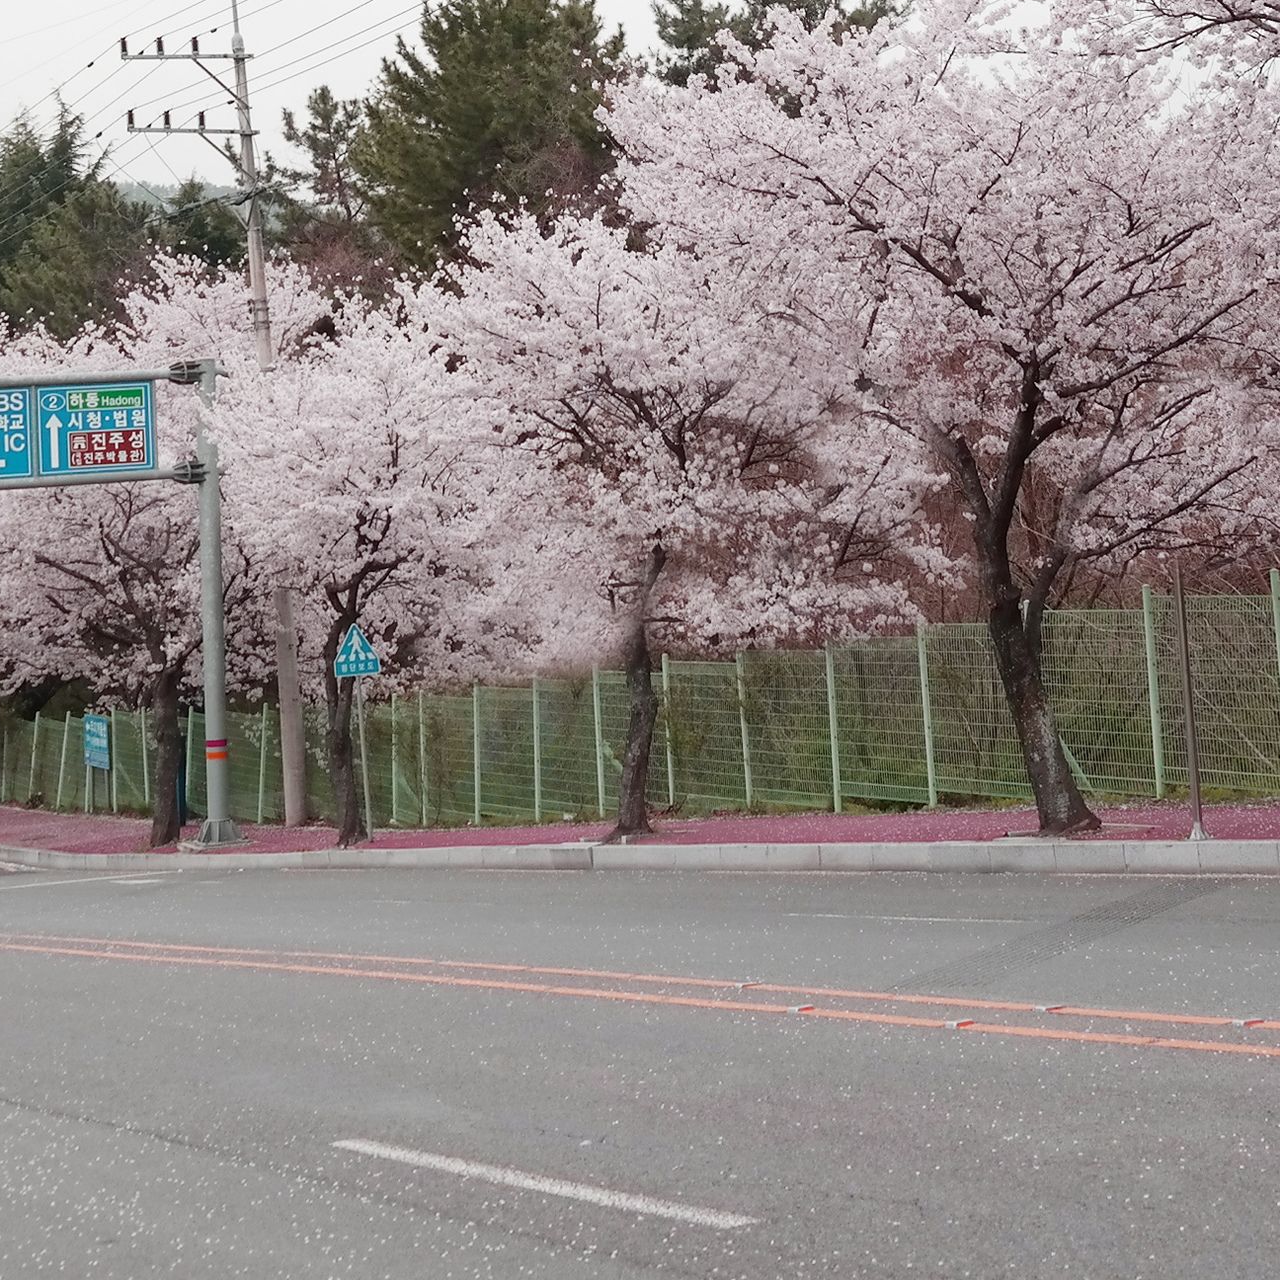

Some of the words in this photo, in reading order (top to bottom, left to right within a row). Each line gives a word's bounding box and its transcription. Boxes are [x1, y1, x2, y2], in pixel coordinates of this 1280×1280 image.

[48, 396, 58, 409] 2
[70, 392, 100, 409] 하동
[101, 396, 141, 407] Hadong
[4, 433, 25, 452] IC
[91, 430, 144, 451] 진주성
